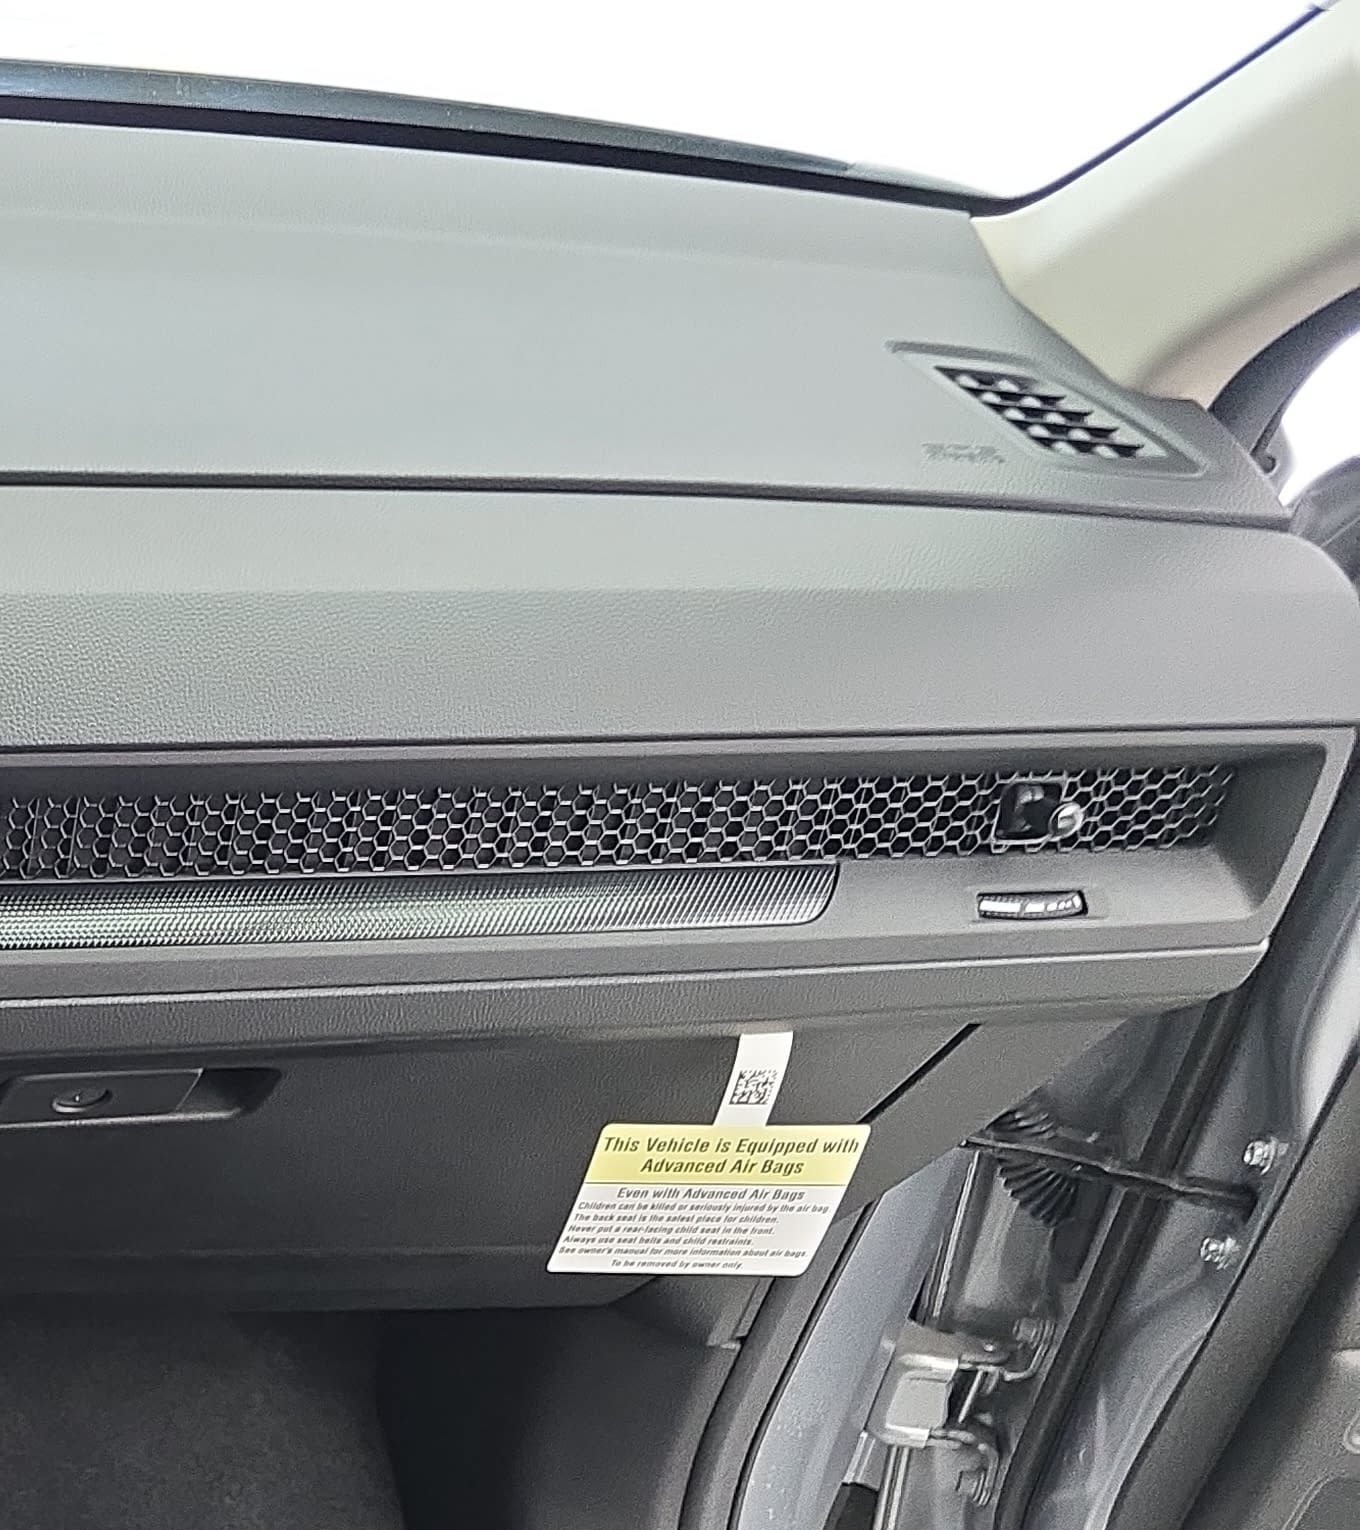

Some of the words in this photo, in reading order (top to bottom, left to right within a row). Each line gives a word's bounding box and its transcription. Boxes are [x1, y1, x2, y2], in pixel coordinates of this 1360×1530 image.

[604, 1137, 640, 1152] This
[647, 1137, 708, 1153] Vehicle
[715, 1138, 730, 1153] is
[735, 1138, 816, 1156] Equipped
[823, 1138, 859, 1153] with
[640, 1158, 725, 1174] Advanced
[730, 1159, 756, 1174] Air
[760, 1160, 804, 1176] Bags
[617, 1188, 649, 1199] Even
[652, 1188, 680, 1199] with
[682, 1188, 746, 1200] Advanced
[749, 1189, 770, 1200] Air
[772, 1189, 805, 1202] Bags
[578, 1202, 616, 1210] Children
[650, 1203, 676, 1211] killed
[690, 1204, 730, 1213] seriously
[733, 1204, 764, 1213] injured
[767, 1204, 778, 1214] by
[780, 1204, 794, 1212] the
[812, 1205, 829, 1214] bag
[574, 1214, 590, 1222] The
[593, 1214, 614, 1222] back
[616, 1214, 636, 1222] seat
[639, 1215, 646, 1223] is
[649, 1215, 664, 1223] the
[666, 1215, 694, 1223] safest
[696, 1215, 722, 1225] place
[724, 1215, 737, 1223] for
[739, 1216, 779, 1224] children.
[568, 1225, 595, 1233] Never
[598, 1225, 612, 1235] put
[622, 1226, 672, 1236] rear-facing
[675, 1226, 698, 1234] child
[700, 1226, 720, 1235] seat
[722, 1227, 731, 1235] in
[733, 1227, 748, 1235] the
[751, 1227, 775, 1235] front.
[563, 1236, 596, 1245] Always
[639, 1237, 664, 1245] belts
[666, 1237, 681, 1245] and
[683, 1237, 706, 1245] child
[769, 1249, 782, 1257] air
[784, 1250, 808, 1258] bags.
[638, 1260, 676, 1268] removed
[722, 1261, 742, 1270] only.
